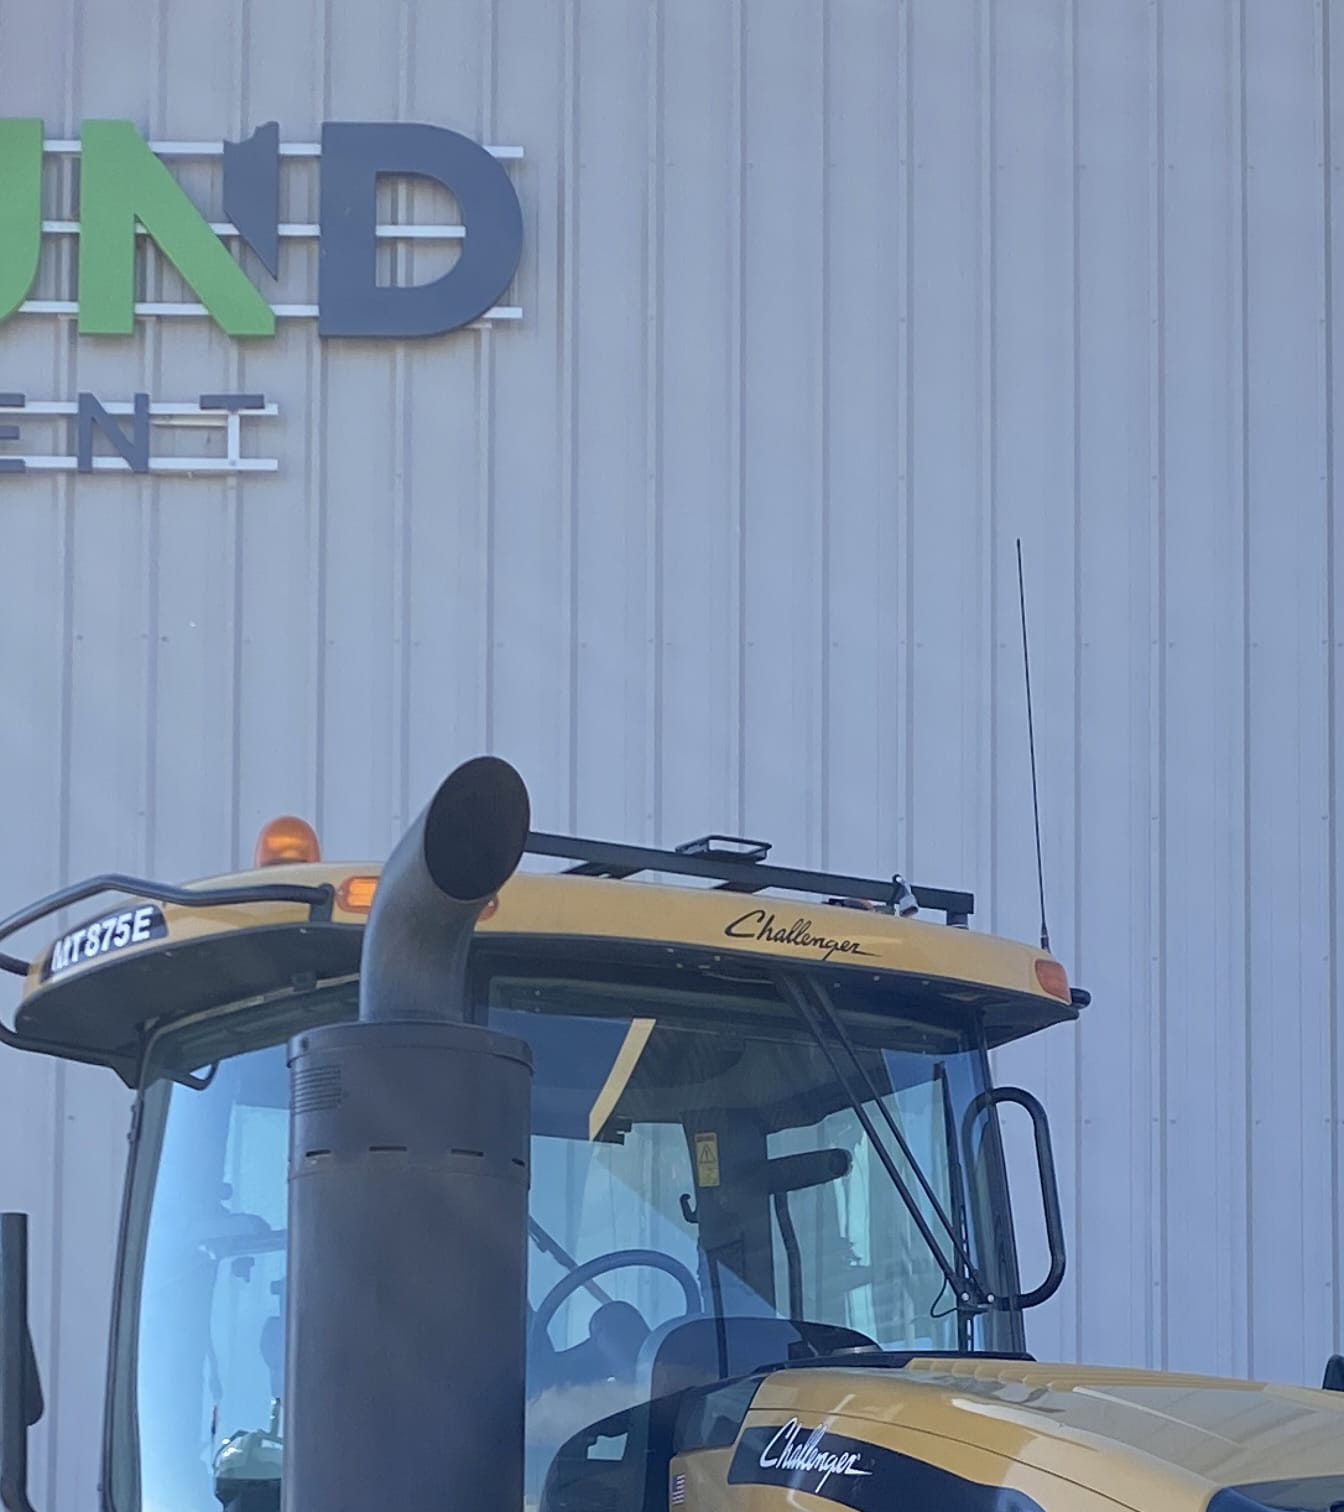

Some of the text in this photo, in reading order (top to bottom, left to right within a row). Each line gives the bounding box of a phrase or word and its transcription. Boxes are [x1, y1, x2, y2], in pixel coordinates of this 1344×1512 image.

[50, 905, 155, 973] MT875E
[724, 909, 882, 961] Challenger
[759, 1415, 873, 1494] Challenger
